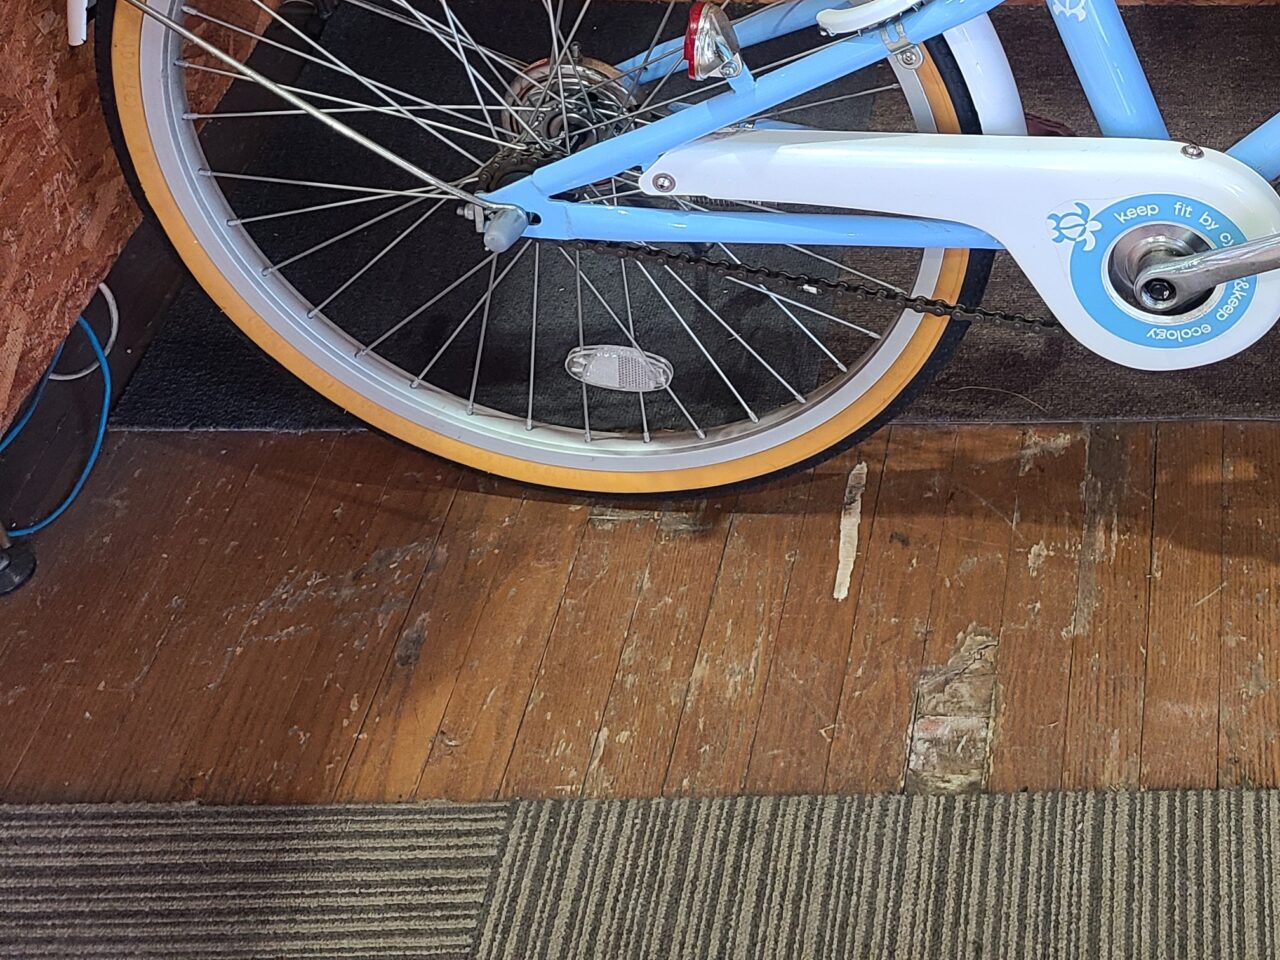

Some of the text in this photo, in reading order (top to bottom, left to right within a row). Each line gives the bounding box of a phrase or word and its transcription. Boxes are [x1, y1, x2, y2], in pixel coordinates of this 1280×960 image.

[1113, 203, 1160, 224] keep
[1173, 201, 1193, 218] fit
[1198, 211, 1220, 230] by
[1146, 324, 1212, 342] ecology
